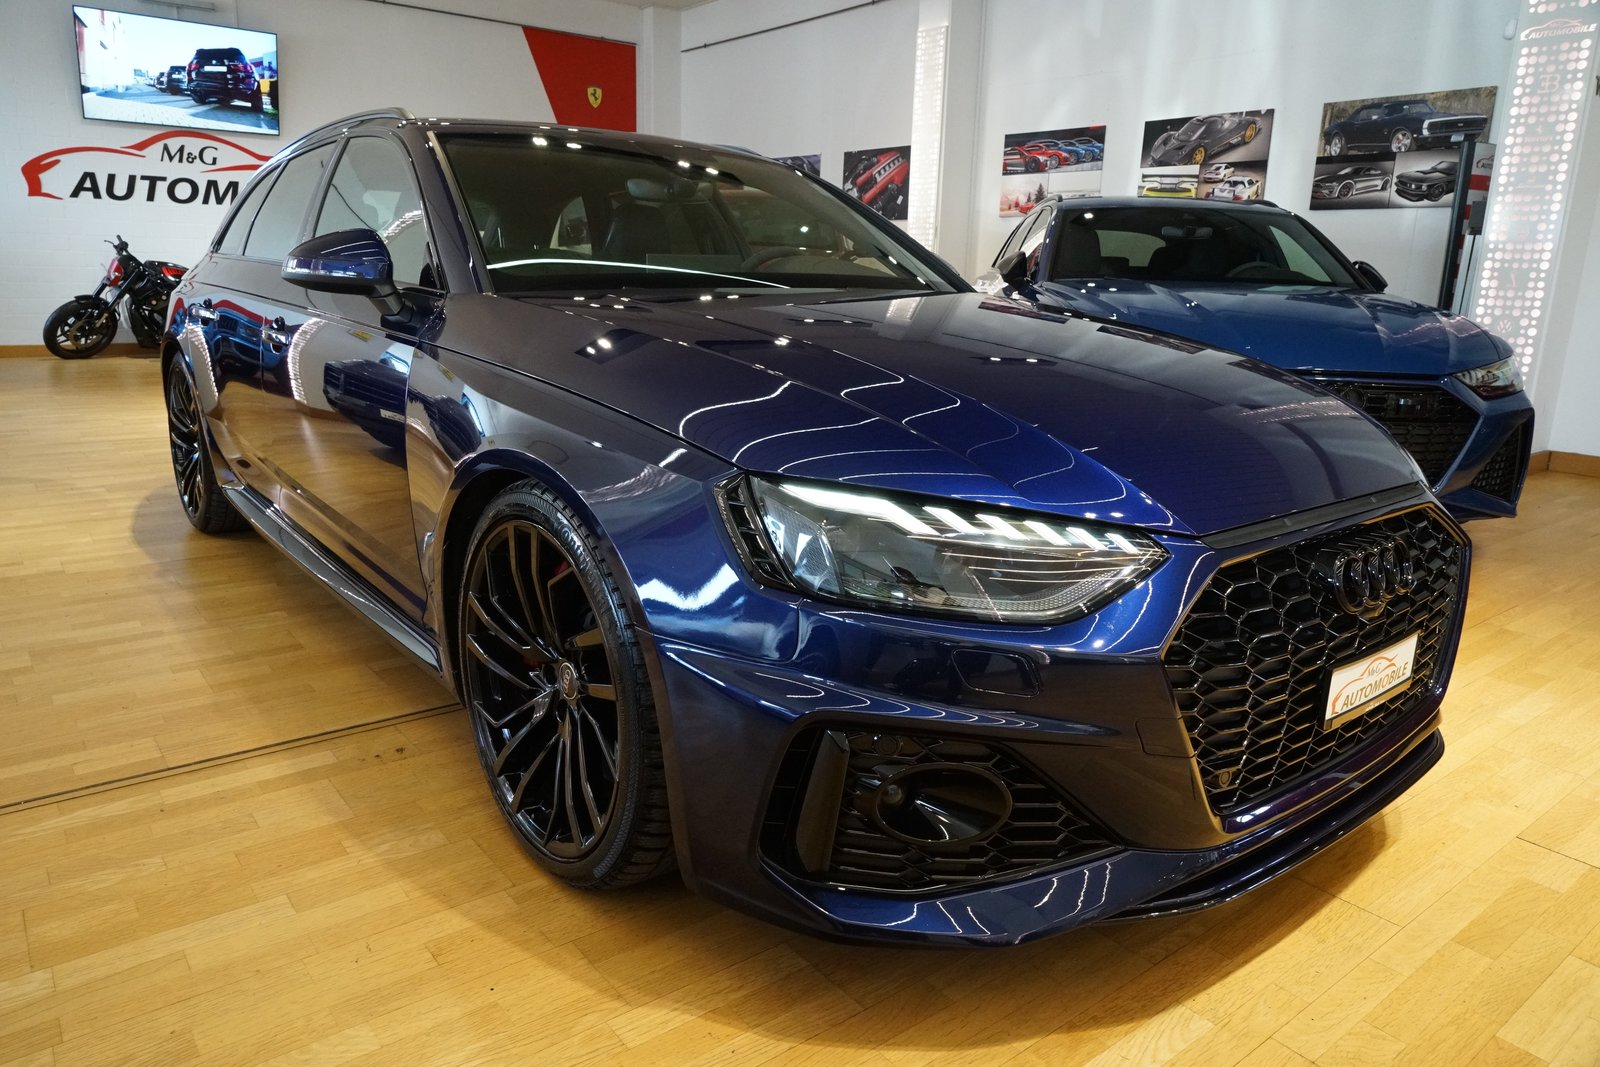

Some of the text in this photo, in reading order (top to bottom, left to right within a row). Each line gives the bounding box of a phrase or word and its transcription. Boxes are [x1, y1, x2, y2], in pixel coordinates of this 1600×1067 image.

[1528, 23, 1597, 39] AUTOMOBILE
[160, 143, 218, 166] M&G
[1340, 661, 1408, 711] AUTOMOBILE
